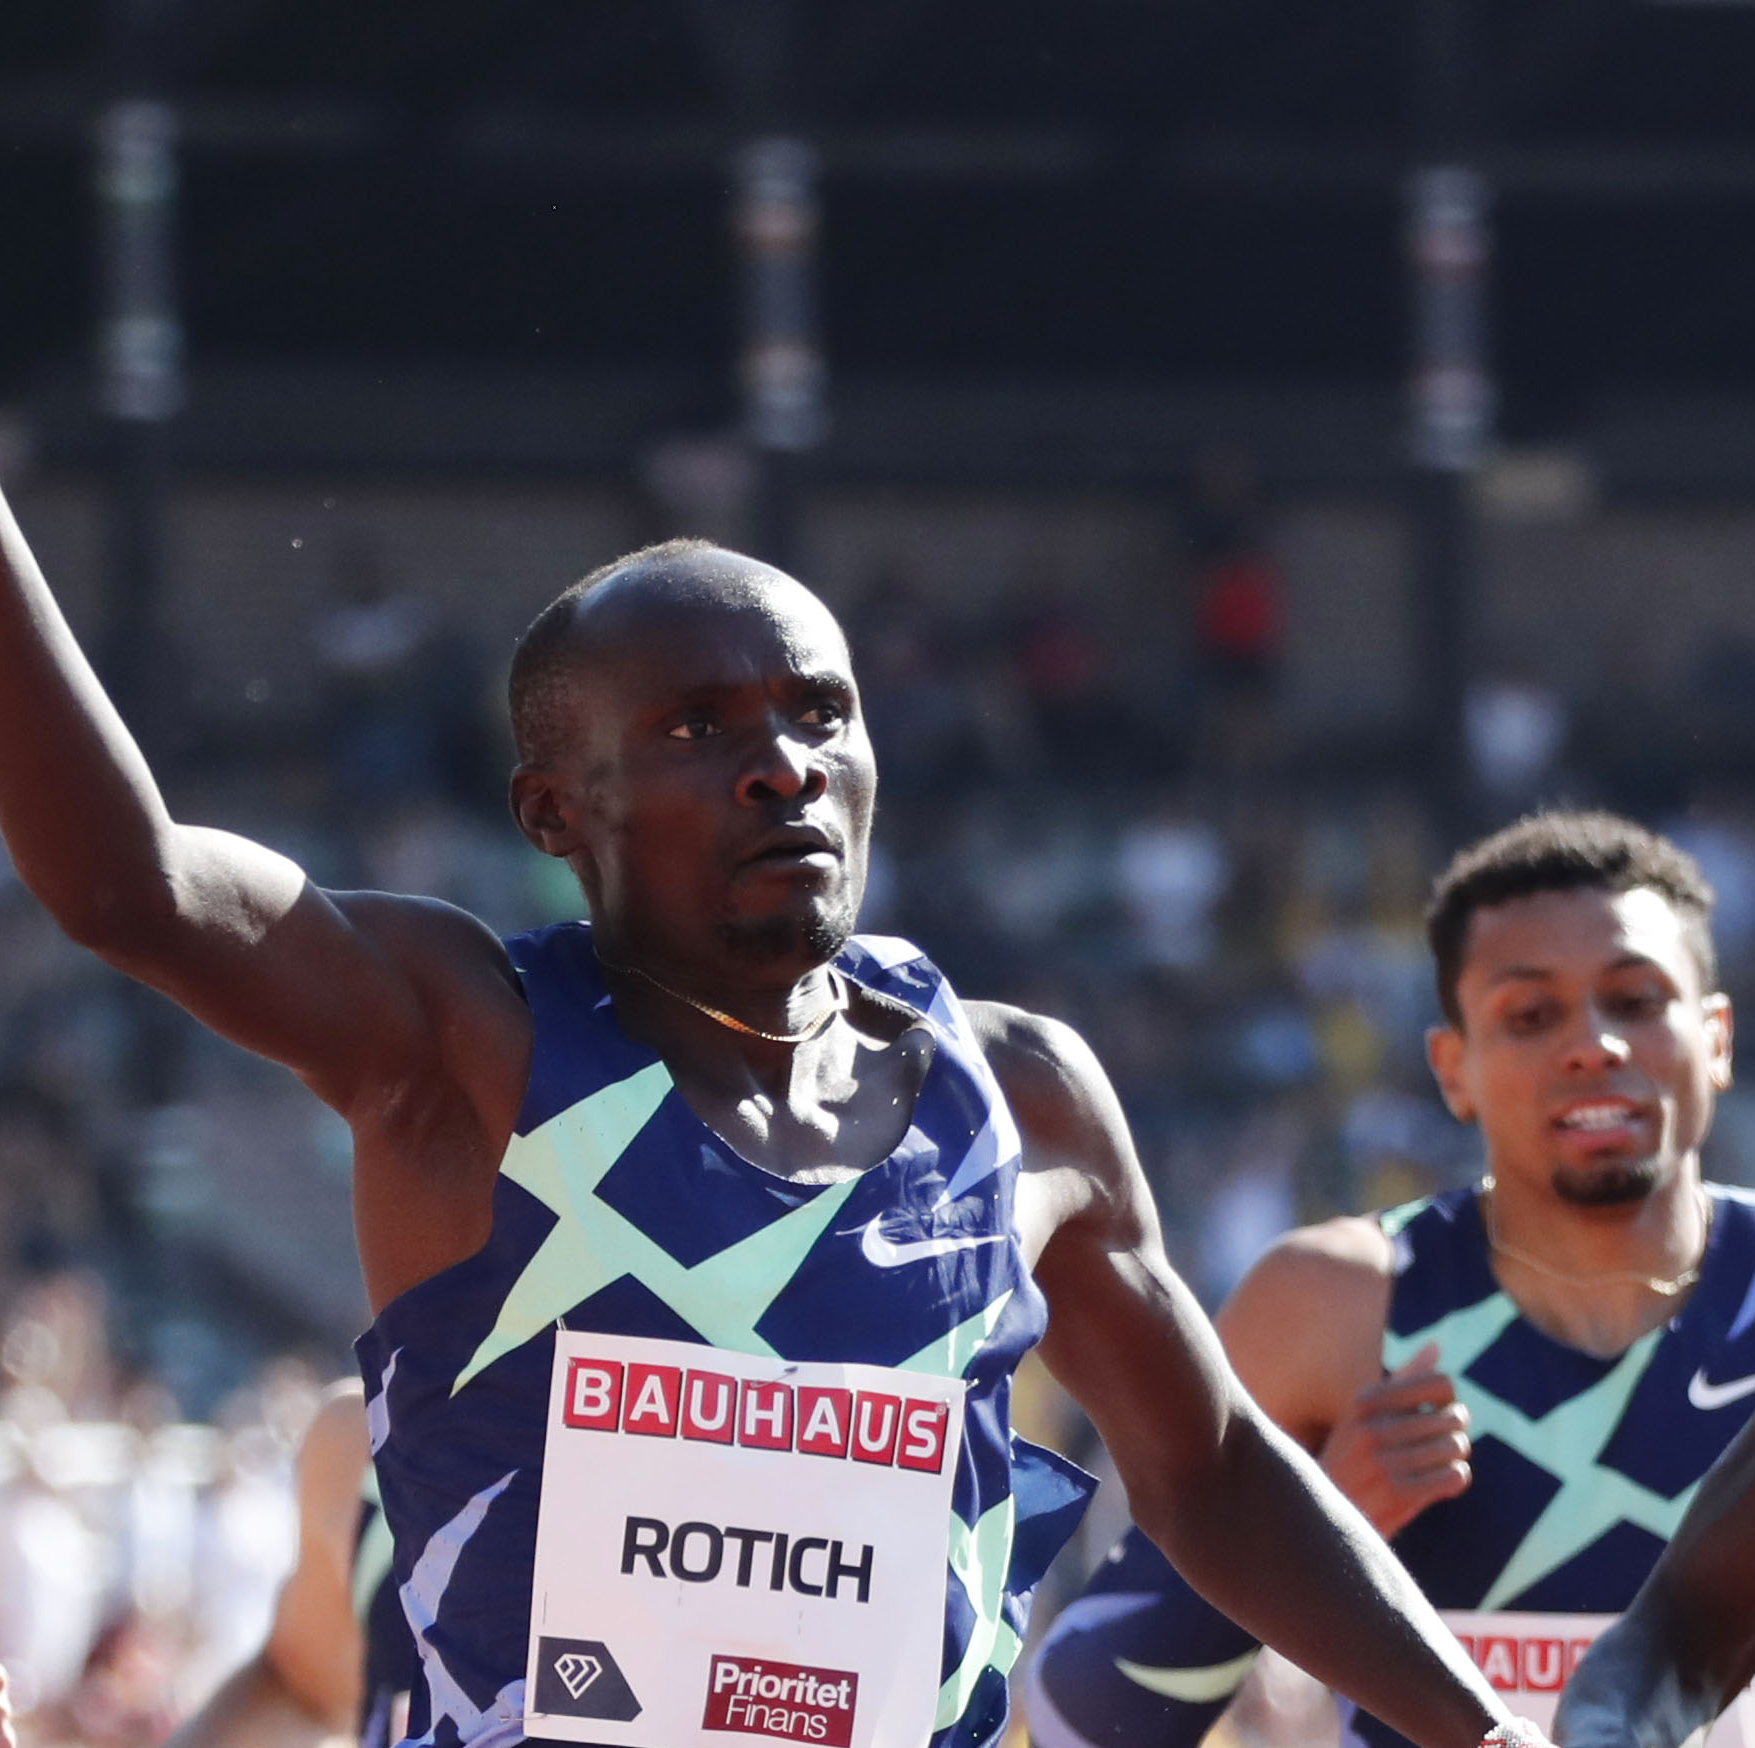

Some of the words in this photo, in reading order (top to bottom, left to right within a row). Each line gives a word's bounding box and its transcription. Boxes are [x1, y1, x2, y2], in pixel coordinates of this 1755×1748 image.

[570, 1363, 940, 1461] BAUHAUS
[619, 1515, 875, 1604] ROTICH
[712, 1661, 852, 1711] Prioritet
[724, 1696, 828, 1739] Finans
